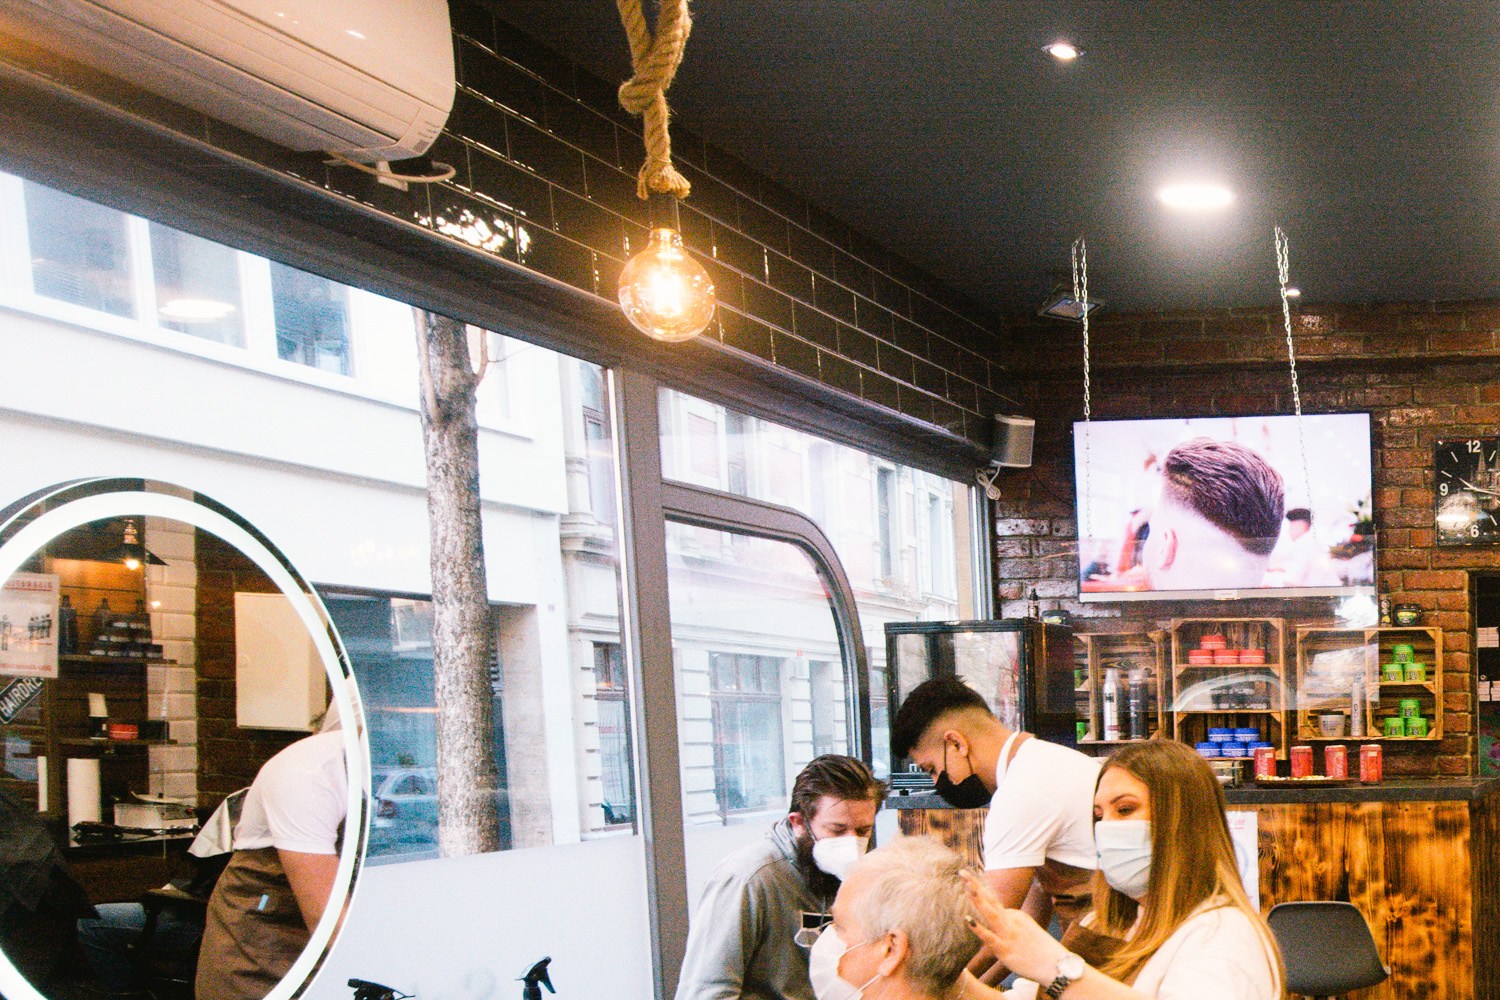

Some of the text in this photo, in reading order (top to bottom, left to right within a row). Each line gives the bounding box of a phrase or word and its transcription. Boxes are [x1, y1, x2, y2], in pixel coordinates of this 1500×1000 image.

[1465, 440, 1481, 453] 12
[1440, 483, 1448, 496] 9
[1470, 524, 1479, 537] 6
